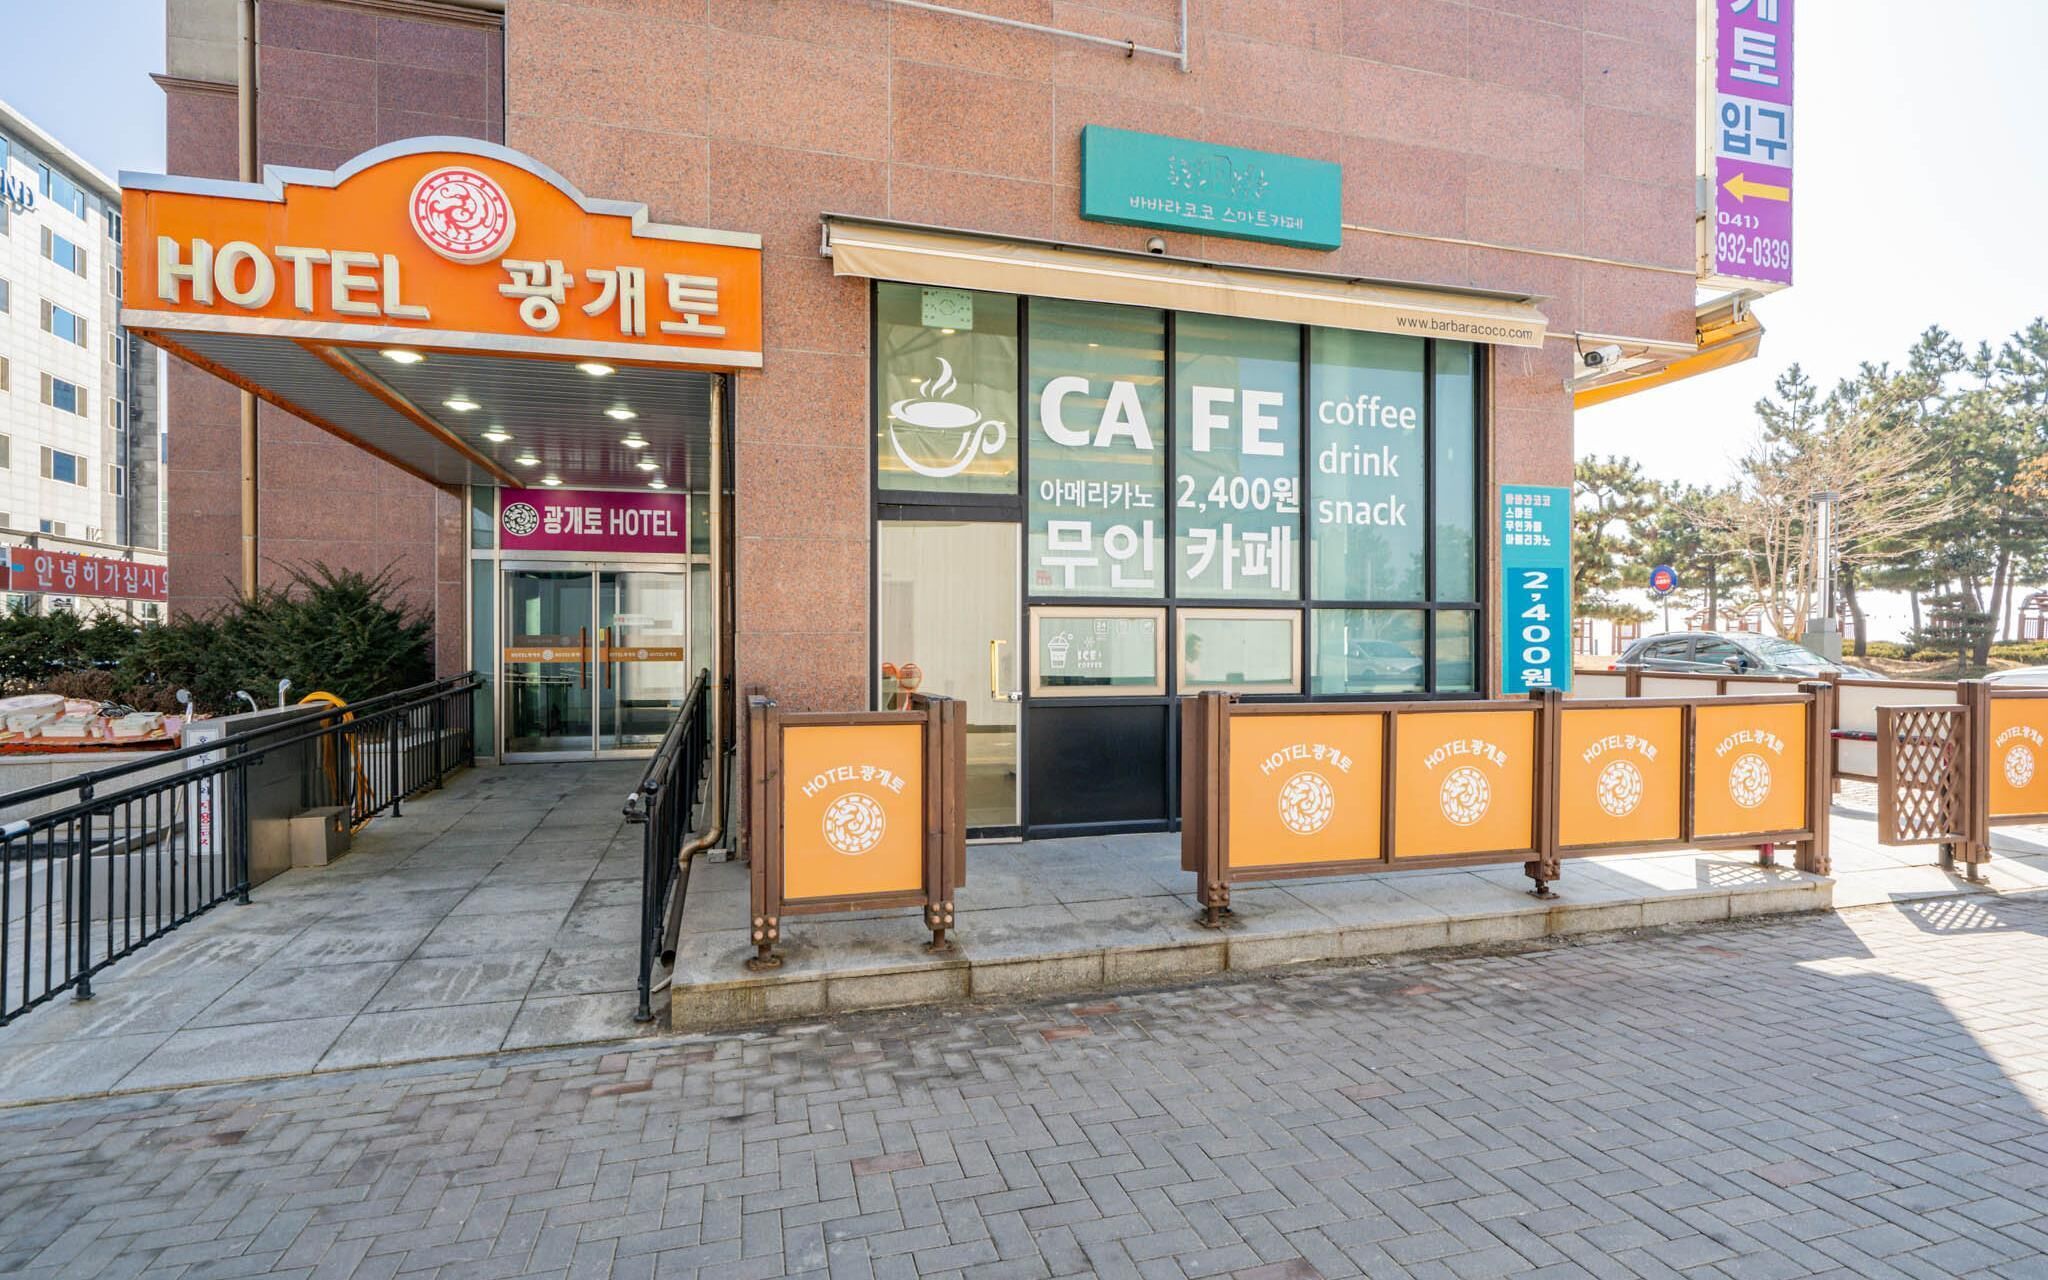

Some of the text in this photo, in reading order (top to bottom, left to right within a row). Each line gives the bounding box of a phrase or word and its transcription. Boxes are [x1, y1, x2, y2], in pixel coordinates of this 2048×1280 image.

[1721, 102, 1787, 161] 입구
[1129, 195, 1303, 229] 바바라코코 스마트카페
[1717, 232, 1790, 270] 932-0339
[157, 235, 726, 339] HOTEL 광개토
[1396, 316, 1533, 340] www.barbaracoco.com
[1318, 394, 1417, 430] coffee
[1319, 442, 1400, 478] drink
[1040, 475, 1299, 513] 아메리카노 2,400원
[1319, 494, 1408, 527] snack
[543, 505, 678, 537] 광개토 HOTEL
[1040, 520, 1291, 592] 무인 카페
[1520, 571, 1552, 687] 2,400원
